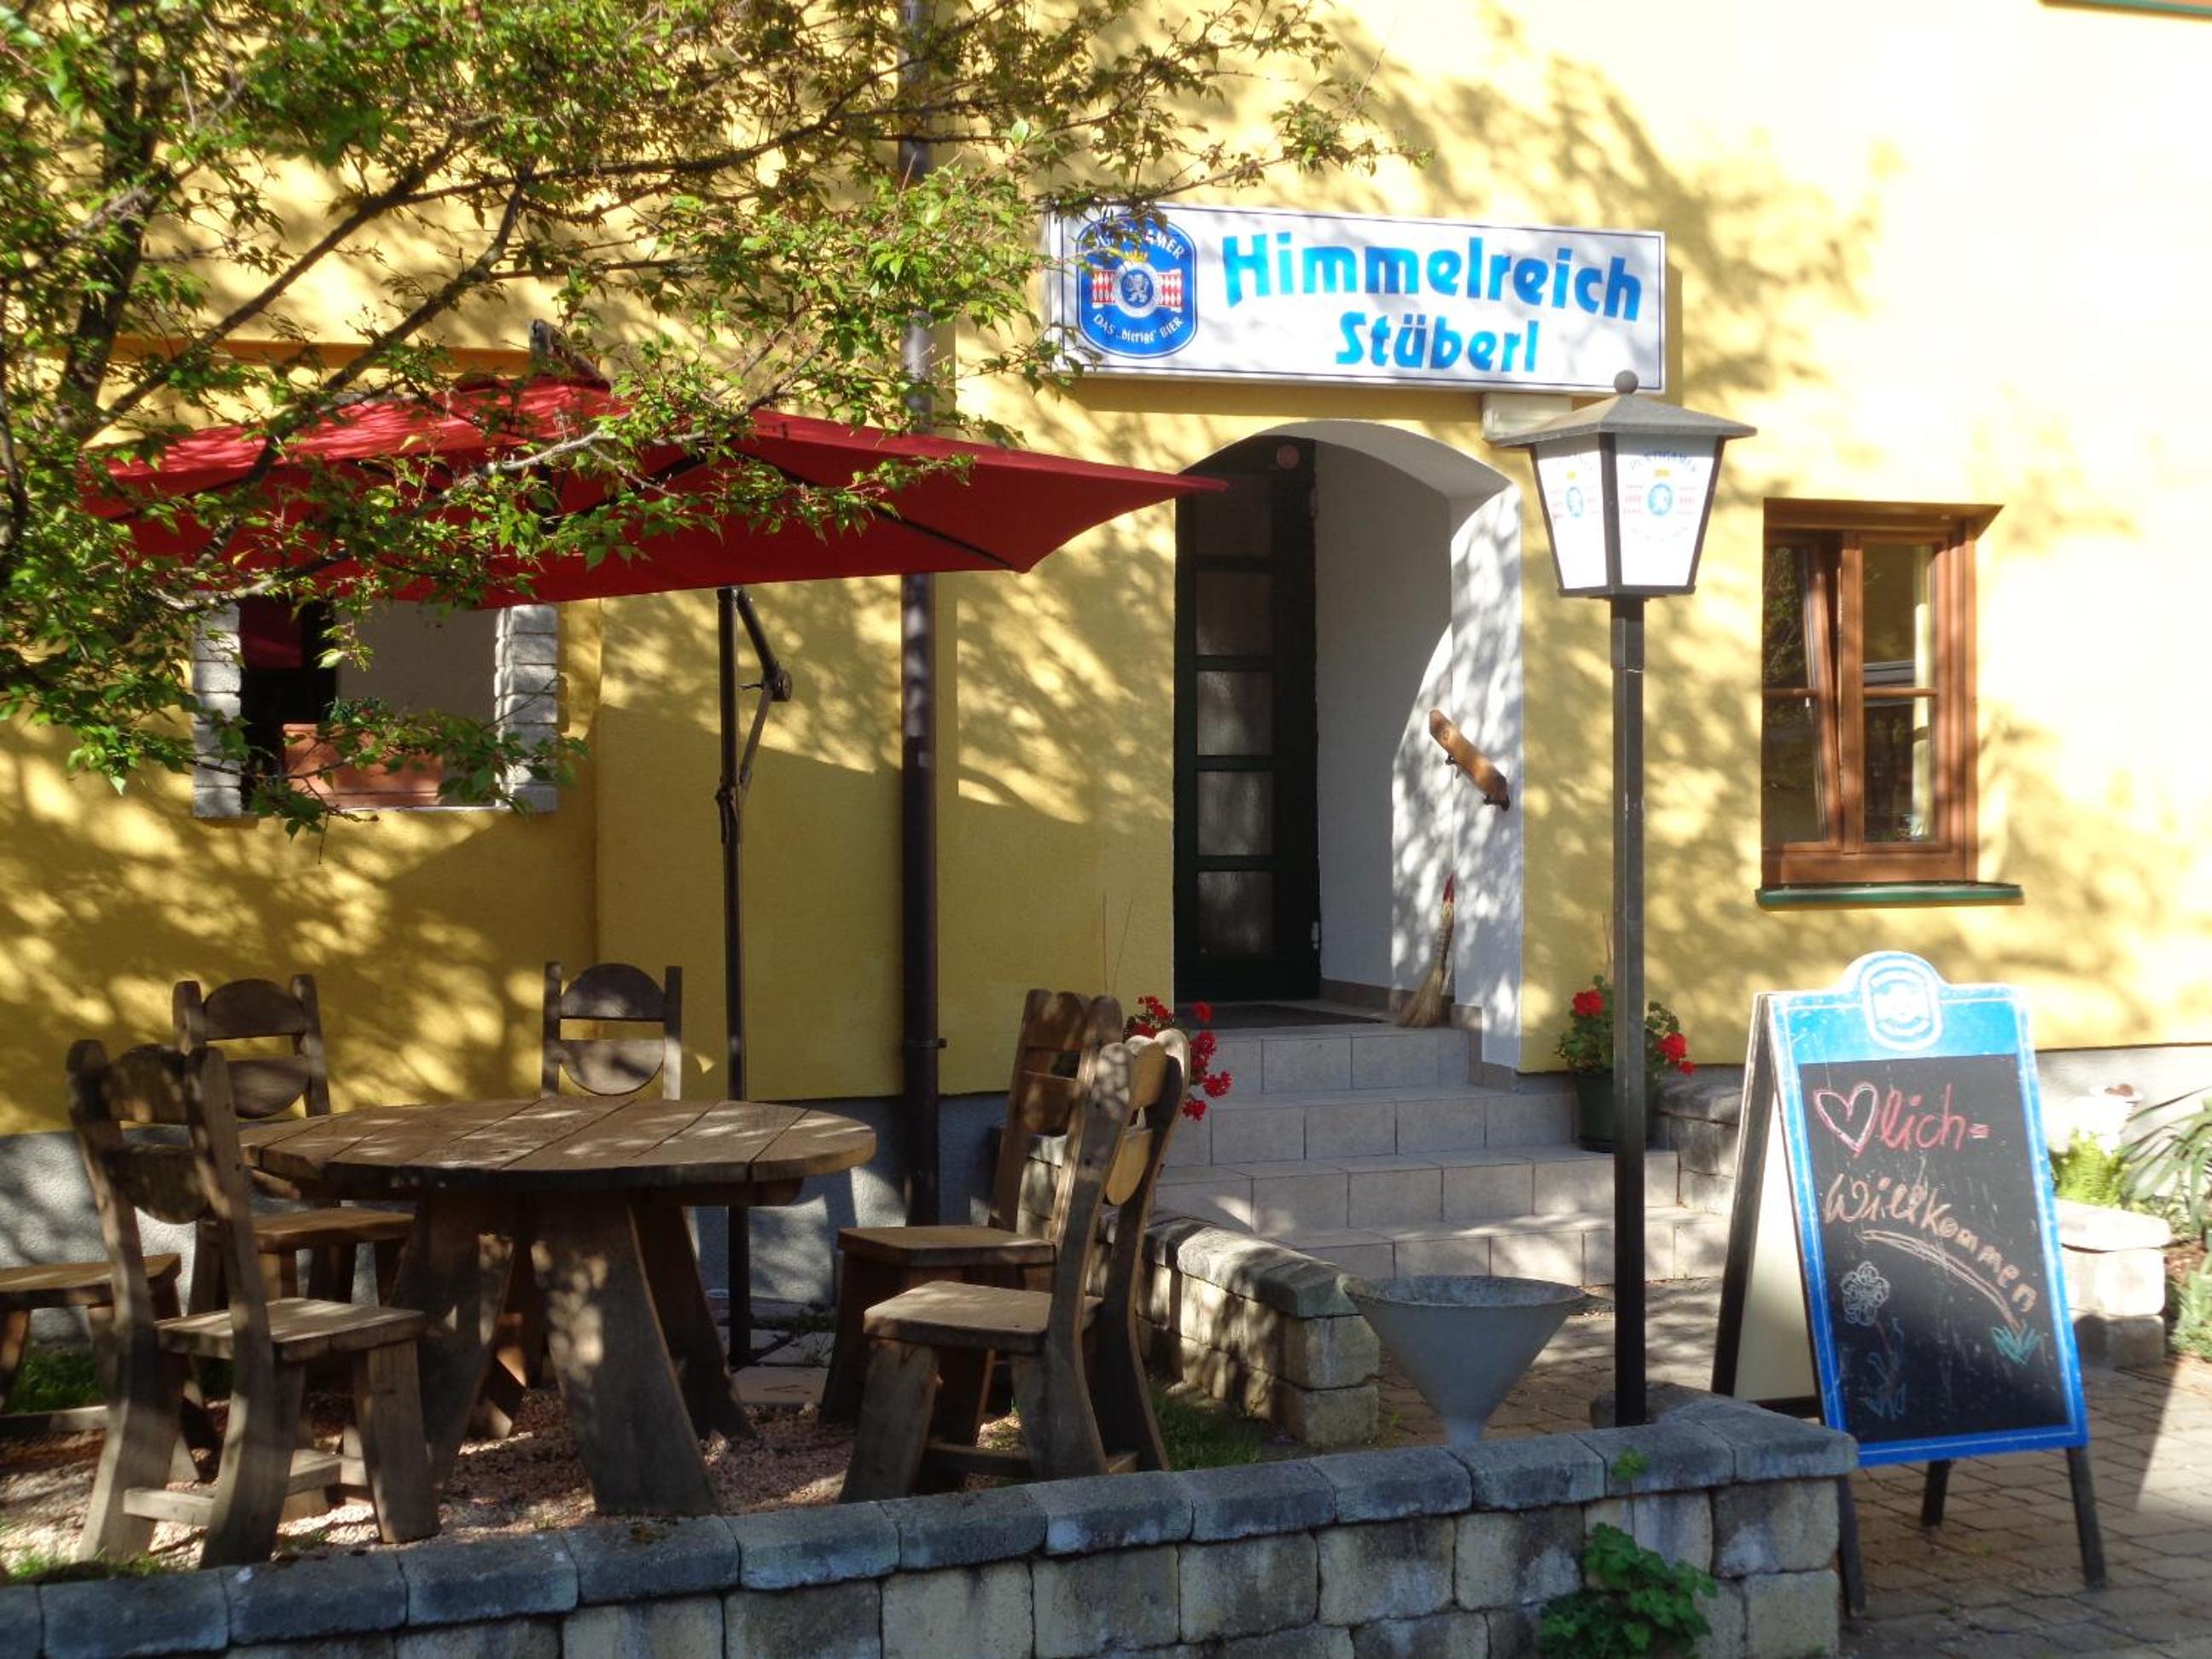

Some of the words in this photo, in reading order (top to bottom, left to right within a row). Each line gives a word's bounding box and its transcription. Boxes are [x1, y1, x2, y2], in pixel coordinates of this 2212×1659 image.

[1221, 231, 1642, 322] Himmelreich
[1092, 313, 1115, 335] DAS
[1159, 317, 1185, 338] BIER
[1336, 311, 1540, 373] Stüberl
